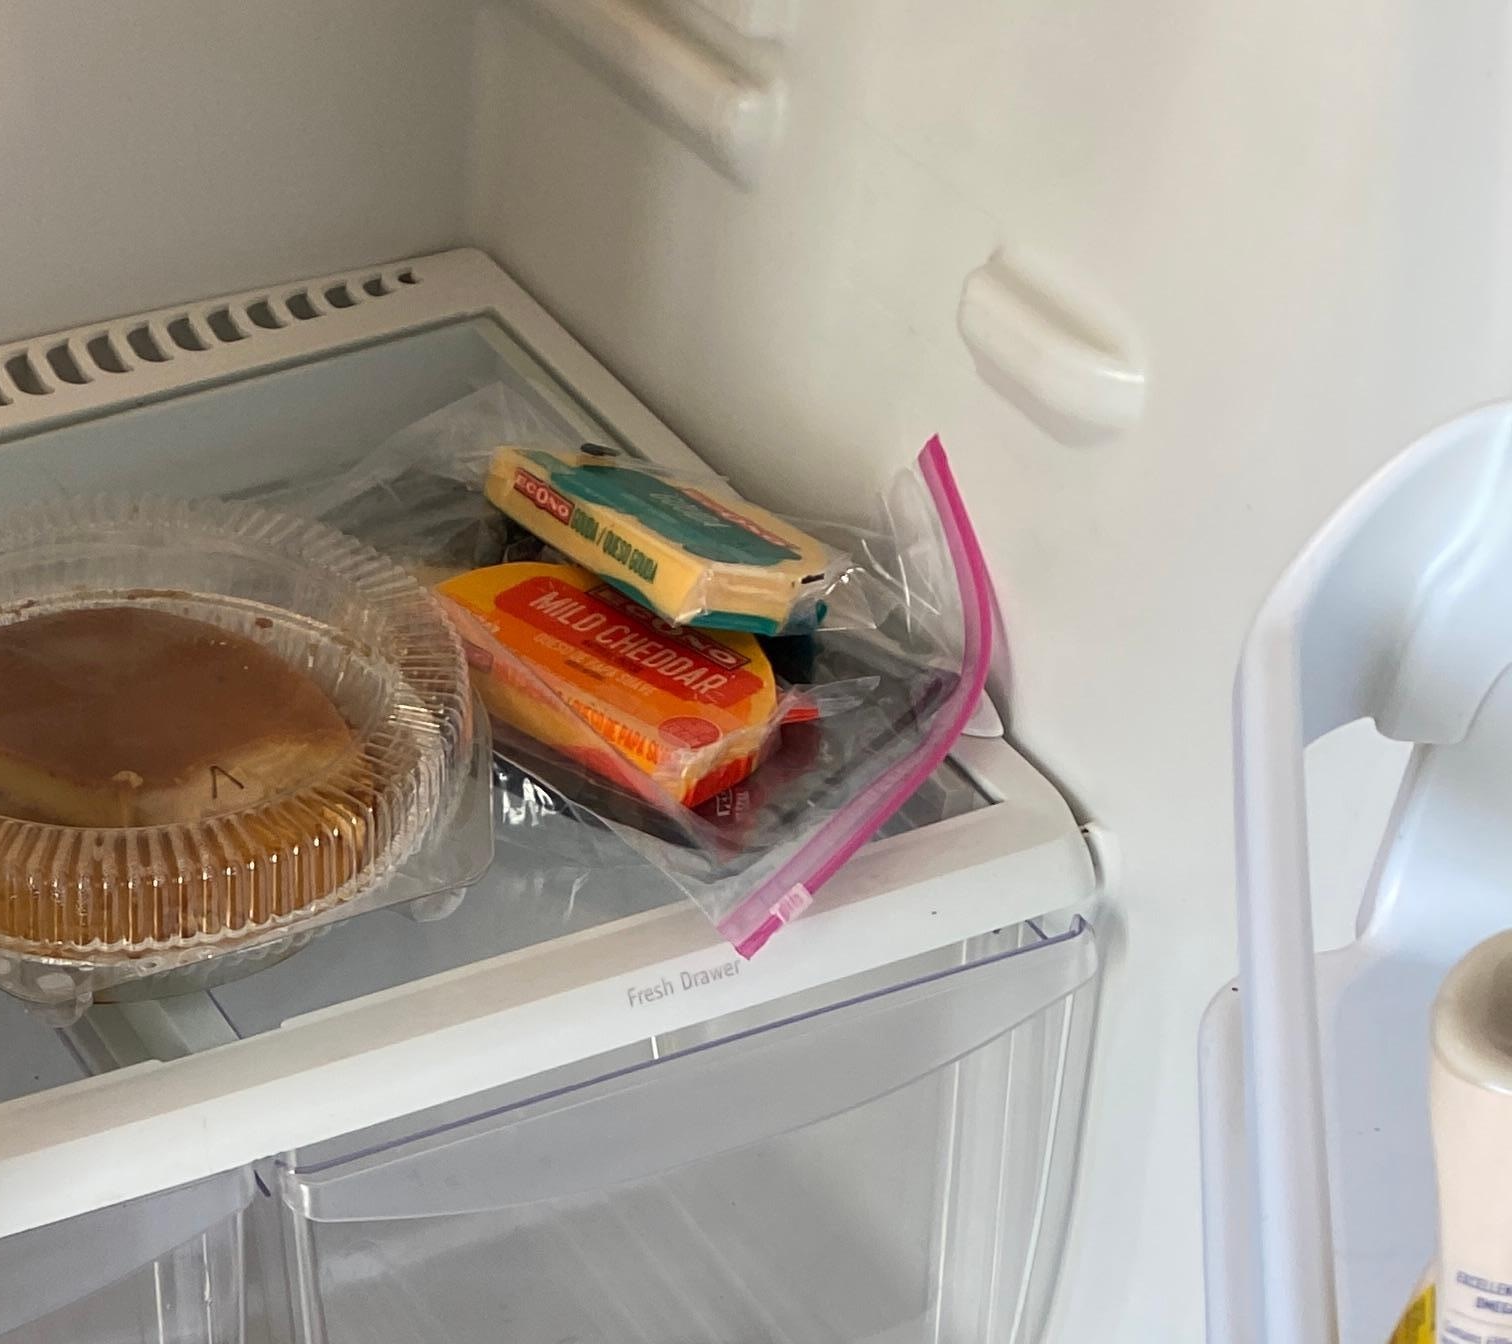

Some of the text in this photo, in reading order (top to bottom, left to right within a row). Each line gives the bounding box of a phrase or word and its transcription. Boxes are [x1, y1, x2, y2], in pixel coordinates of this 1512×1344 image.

[514, 473, 570, 518] ECONO
[529, 591, 606, 632] MILD
[596, 625, 728, 694] CHEDDAR
[627, 959, 742, 1008] Fresh Drawer
